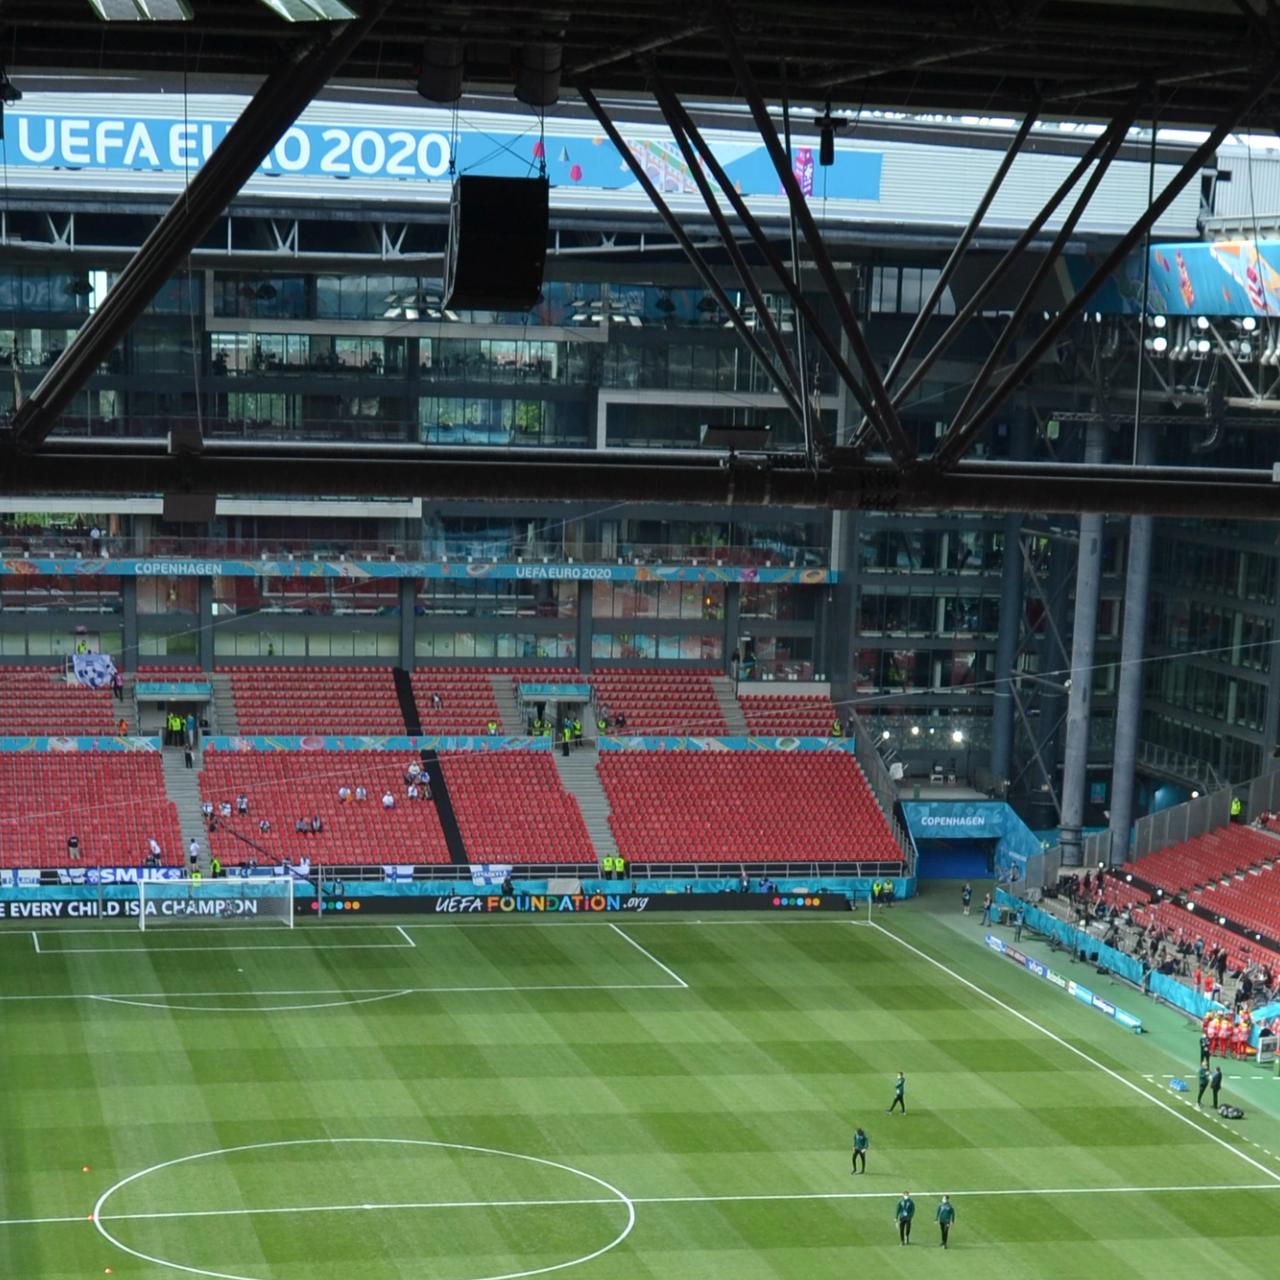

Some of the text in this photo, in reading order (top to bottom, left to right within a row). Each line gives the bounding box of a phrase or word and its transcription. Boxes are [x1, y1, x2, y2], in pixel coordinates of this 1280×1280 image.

[18, 117, 450, 176] UEFA EO 2020
[134, 562, 223, 575] COPENHAGEN
[516, 567, 612, 579] UEFA EURO 2020
[921, 816, 985, 826] COPENHAGEN
[9, 902, 63, 917] EVERY
[145, 900, 157, 915] A
[435, 896, 484, 913] UEFA
[623, 896, 650, 911] .org
